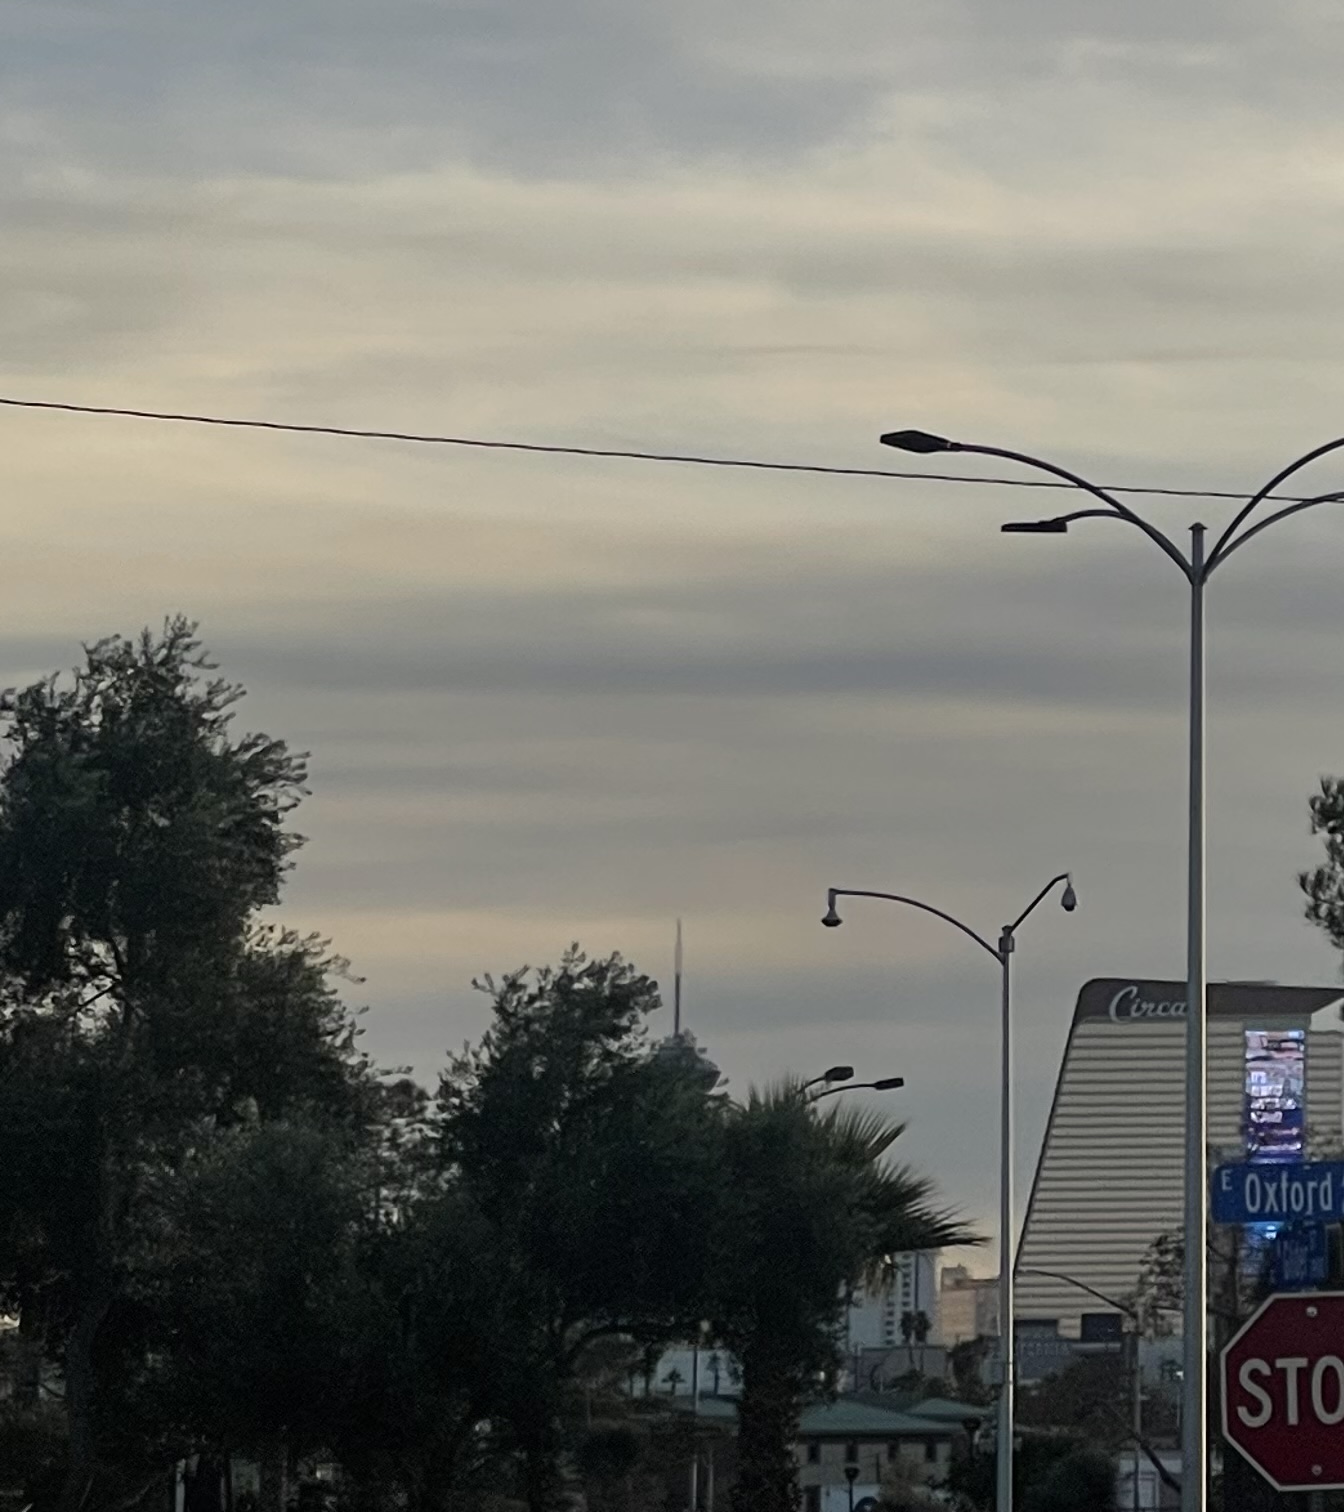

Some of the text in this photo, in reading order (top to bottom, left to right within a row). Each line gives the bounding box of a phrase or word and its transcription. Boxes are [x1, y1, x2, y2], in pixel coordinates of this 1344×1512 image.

[1110, 985, 1187, 1024] Circa
[1221, 1170, 1233, 1191] E
[1244, 1170, 1333, 1215] Oxford
